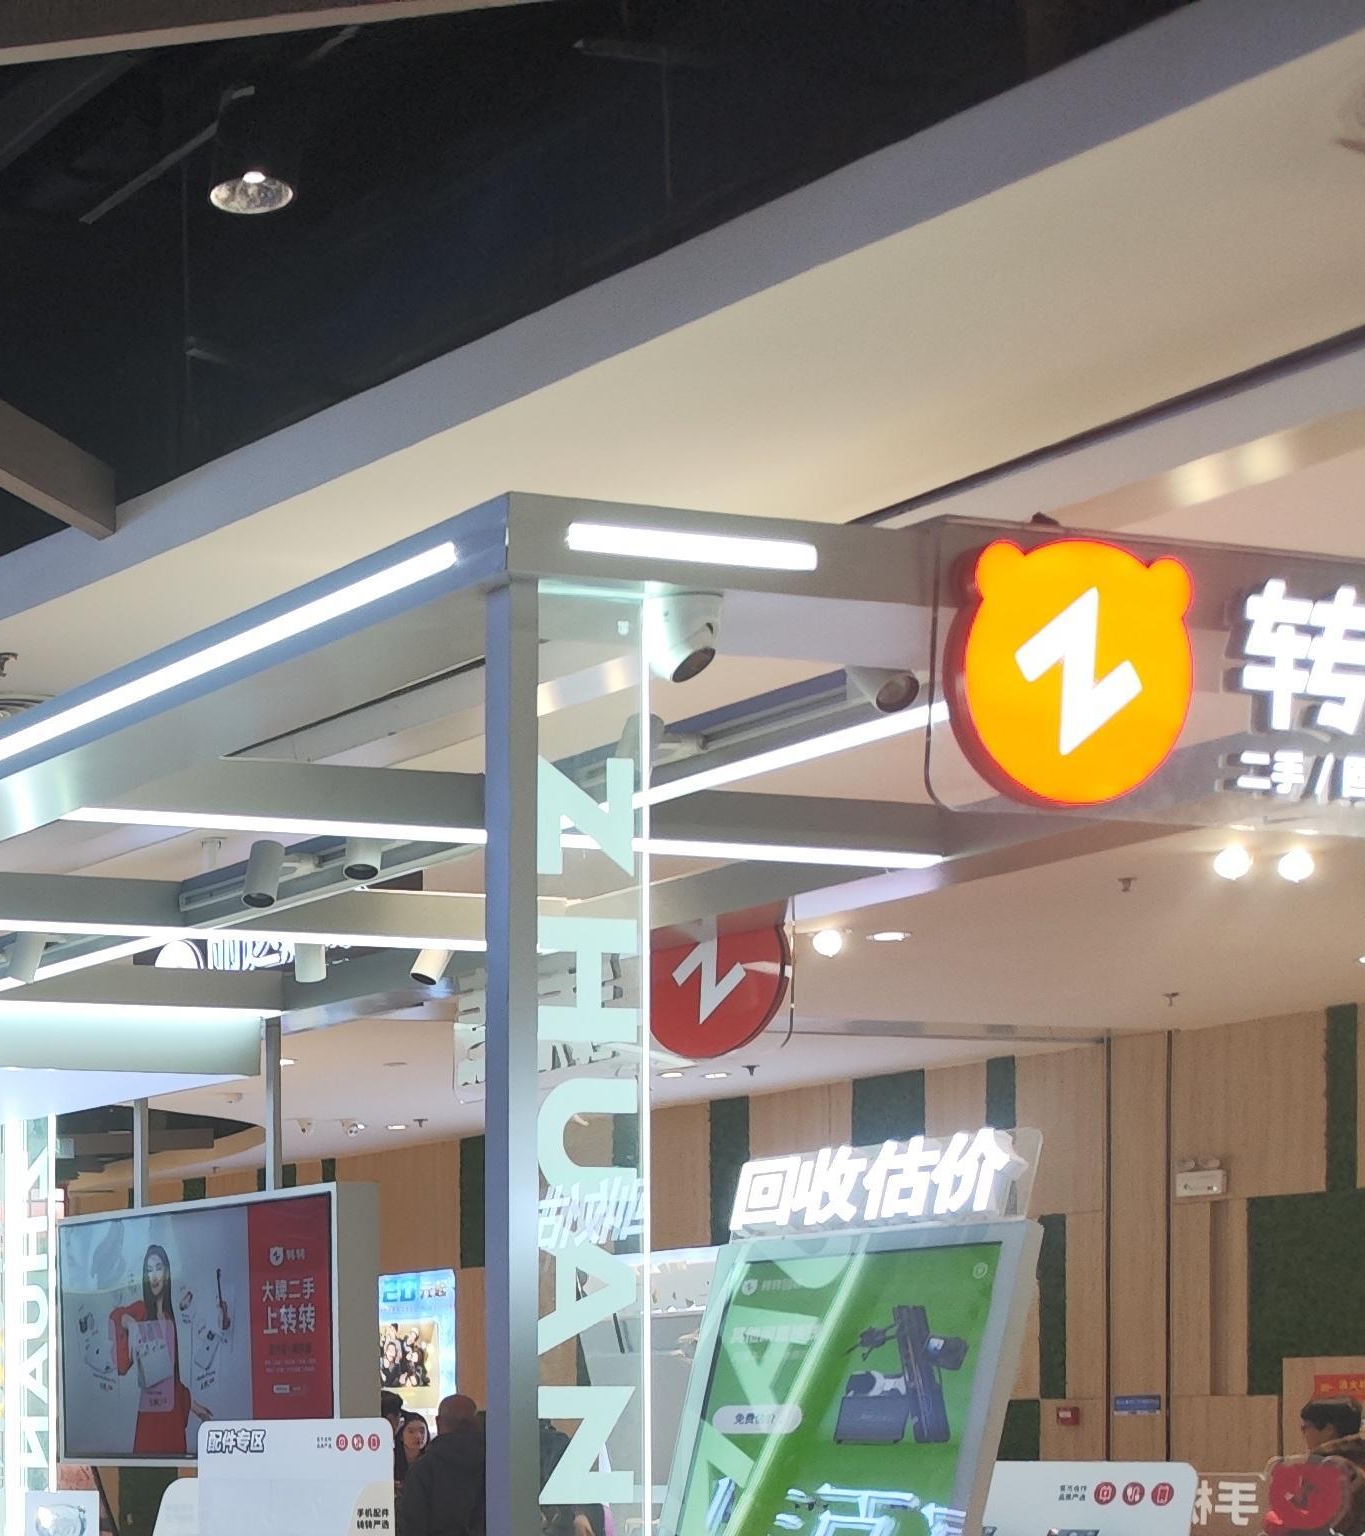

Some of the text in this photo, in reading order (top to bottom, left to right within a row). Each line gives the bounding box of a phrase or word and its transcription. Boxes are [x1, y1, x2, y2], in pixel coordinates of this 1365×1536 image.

[730, 1127, 1010, 1231] 回收估价
[262, 1277, 315, 1302] 大牌二手
[263, 1303, 316, 1335] 上转转
[206, 1428, 267, 1454] 配件专区
[356, 1507, 390, 1518] 手机配件
[356, 1519, 390, 1530] 转转严选
